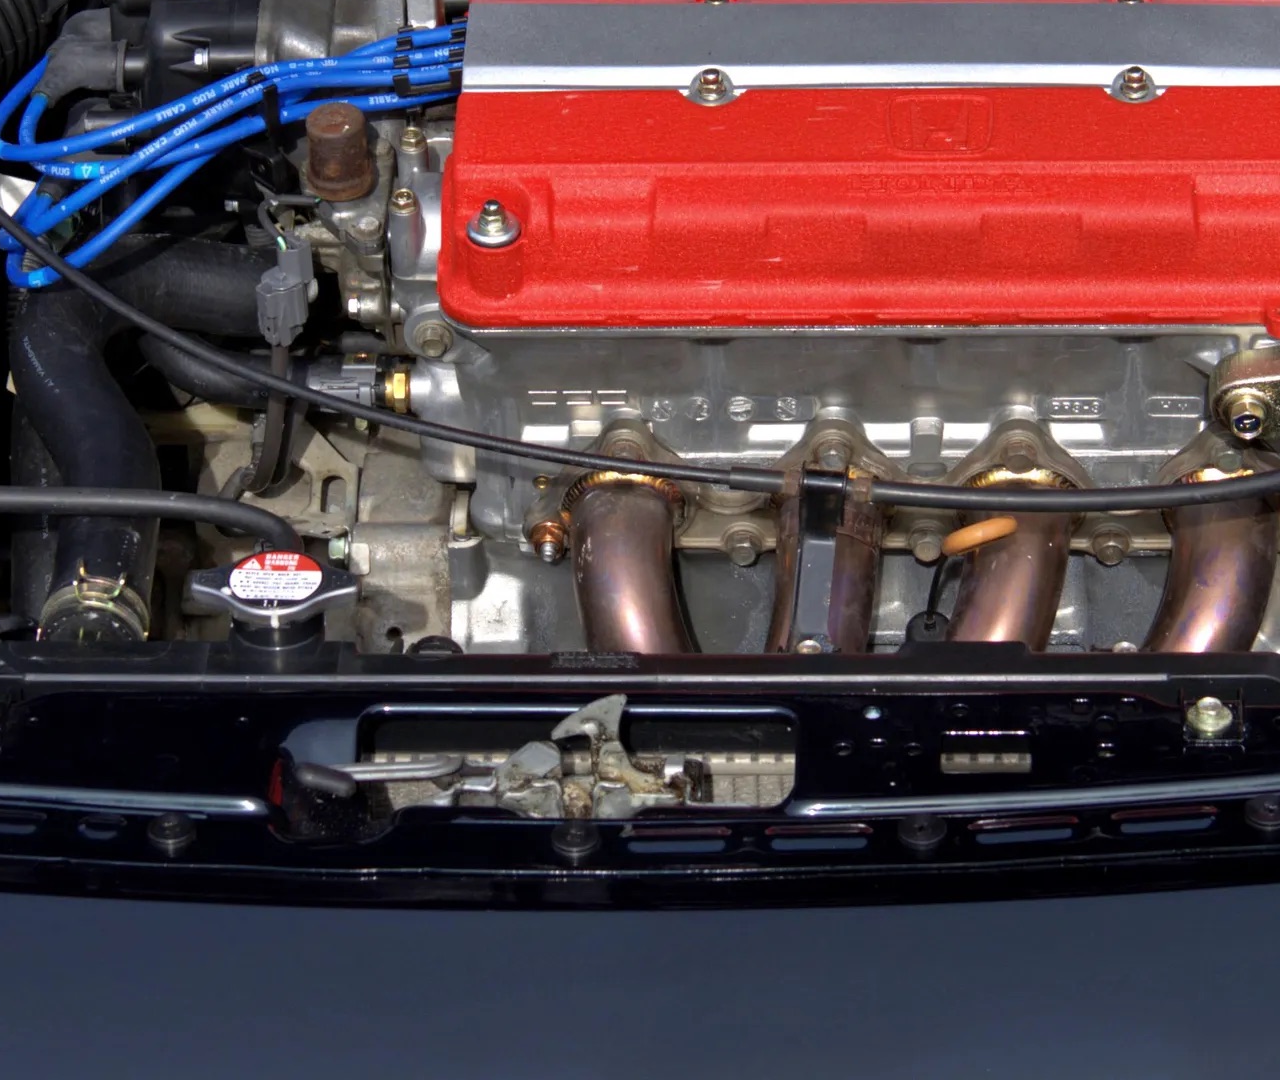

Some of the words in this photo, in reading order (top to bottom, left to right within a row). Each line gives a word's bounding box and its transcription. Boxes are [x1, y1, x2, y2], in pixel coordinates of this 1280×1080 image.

[191, 89, 216, 106] PLUG
[368, 95, 399, 106] CABLE
[155, 103, 186, 122] CABLE
[202, 98, 235, 119] SPARK
[111, 123, 136, 137] JAPAN
[172, 118, 198, 138] PLUG
[137, 136, 168, 160] CABLE
[51, 164, 71, 177] PLUG
[99, 166, 121, 185] JAPAN
